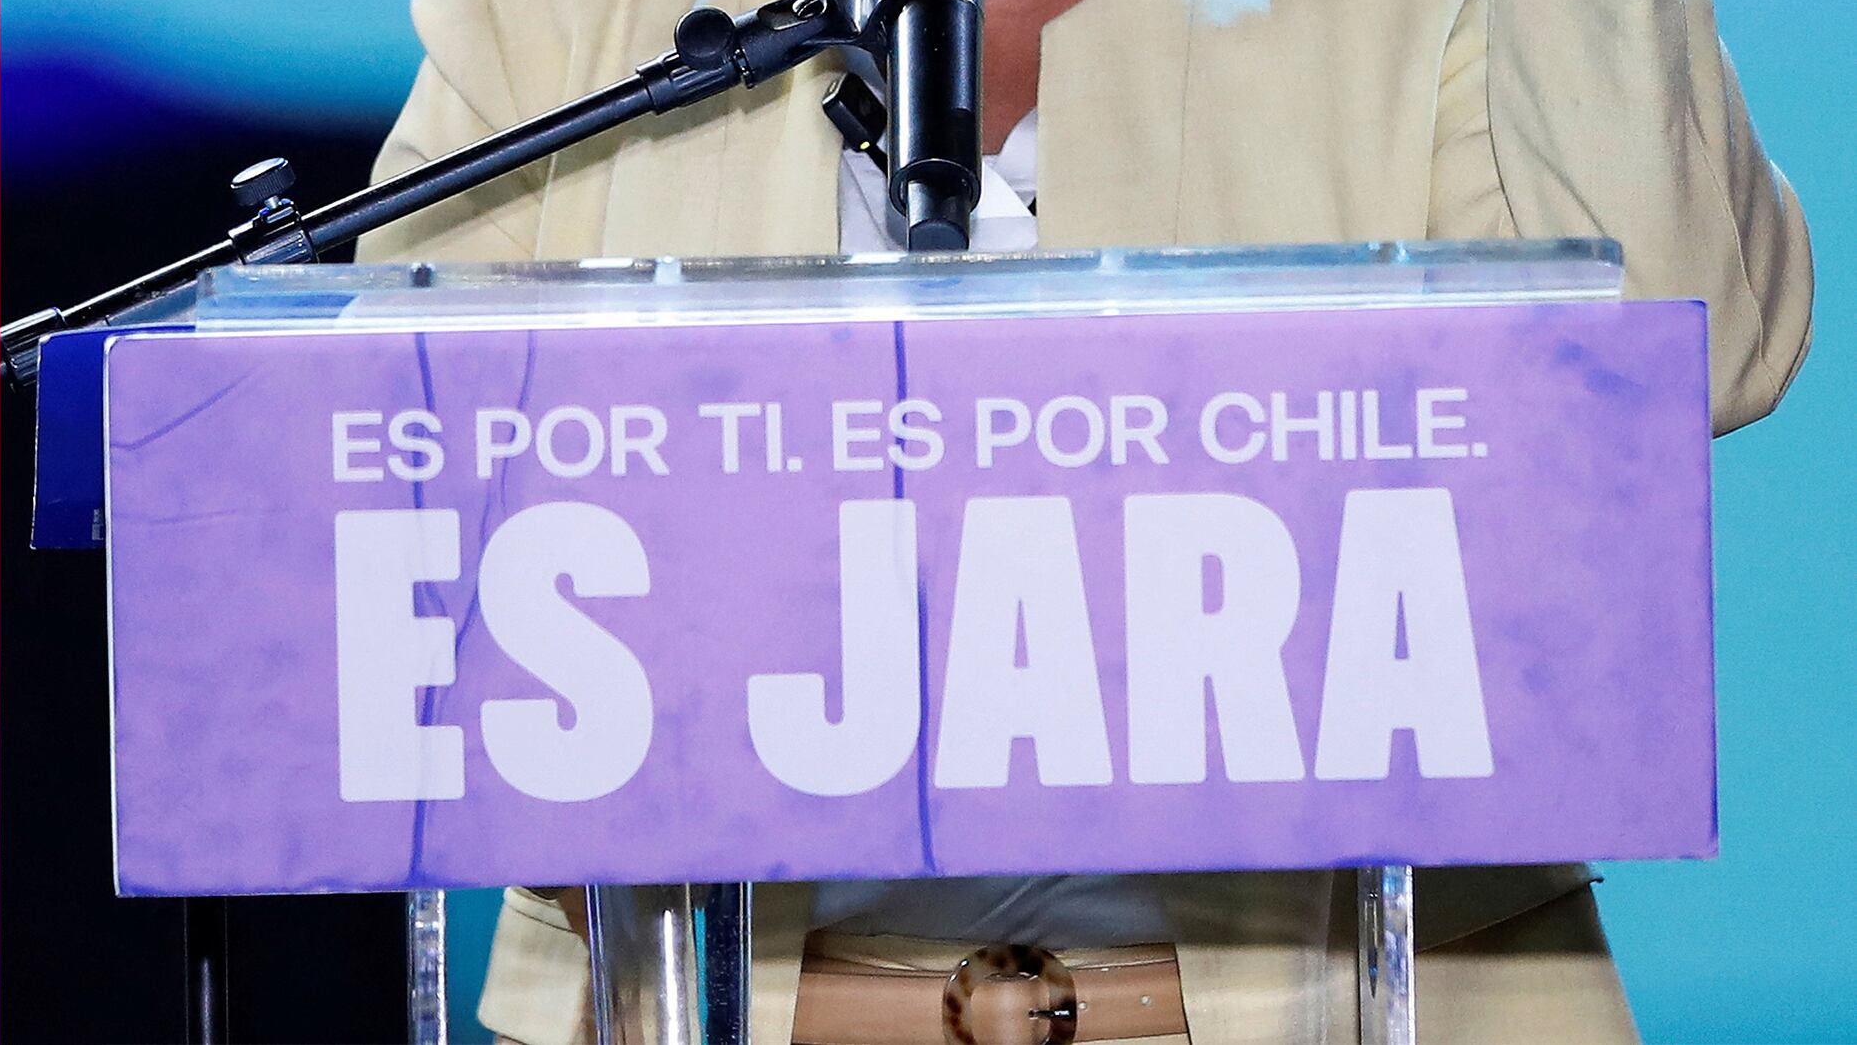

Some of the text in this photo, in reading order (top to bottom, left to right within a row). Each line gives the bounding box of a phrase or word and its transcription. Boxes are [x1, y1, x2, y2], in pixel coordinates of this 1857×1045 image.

[333, 386, 1490, 482] ES POR TI. ES POR CHILE.
[333, 486, 1495, 803] ES JARA
